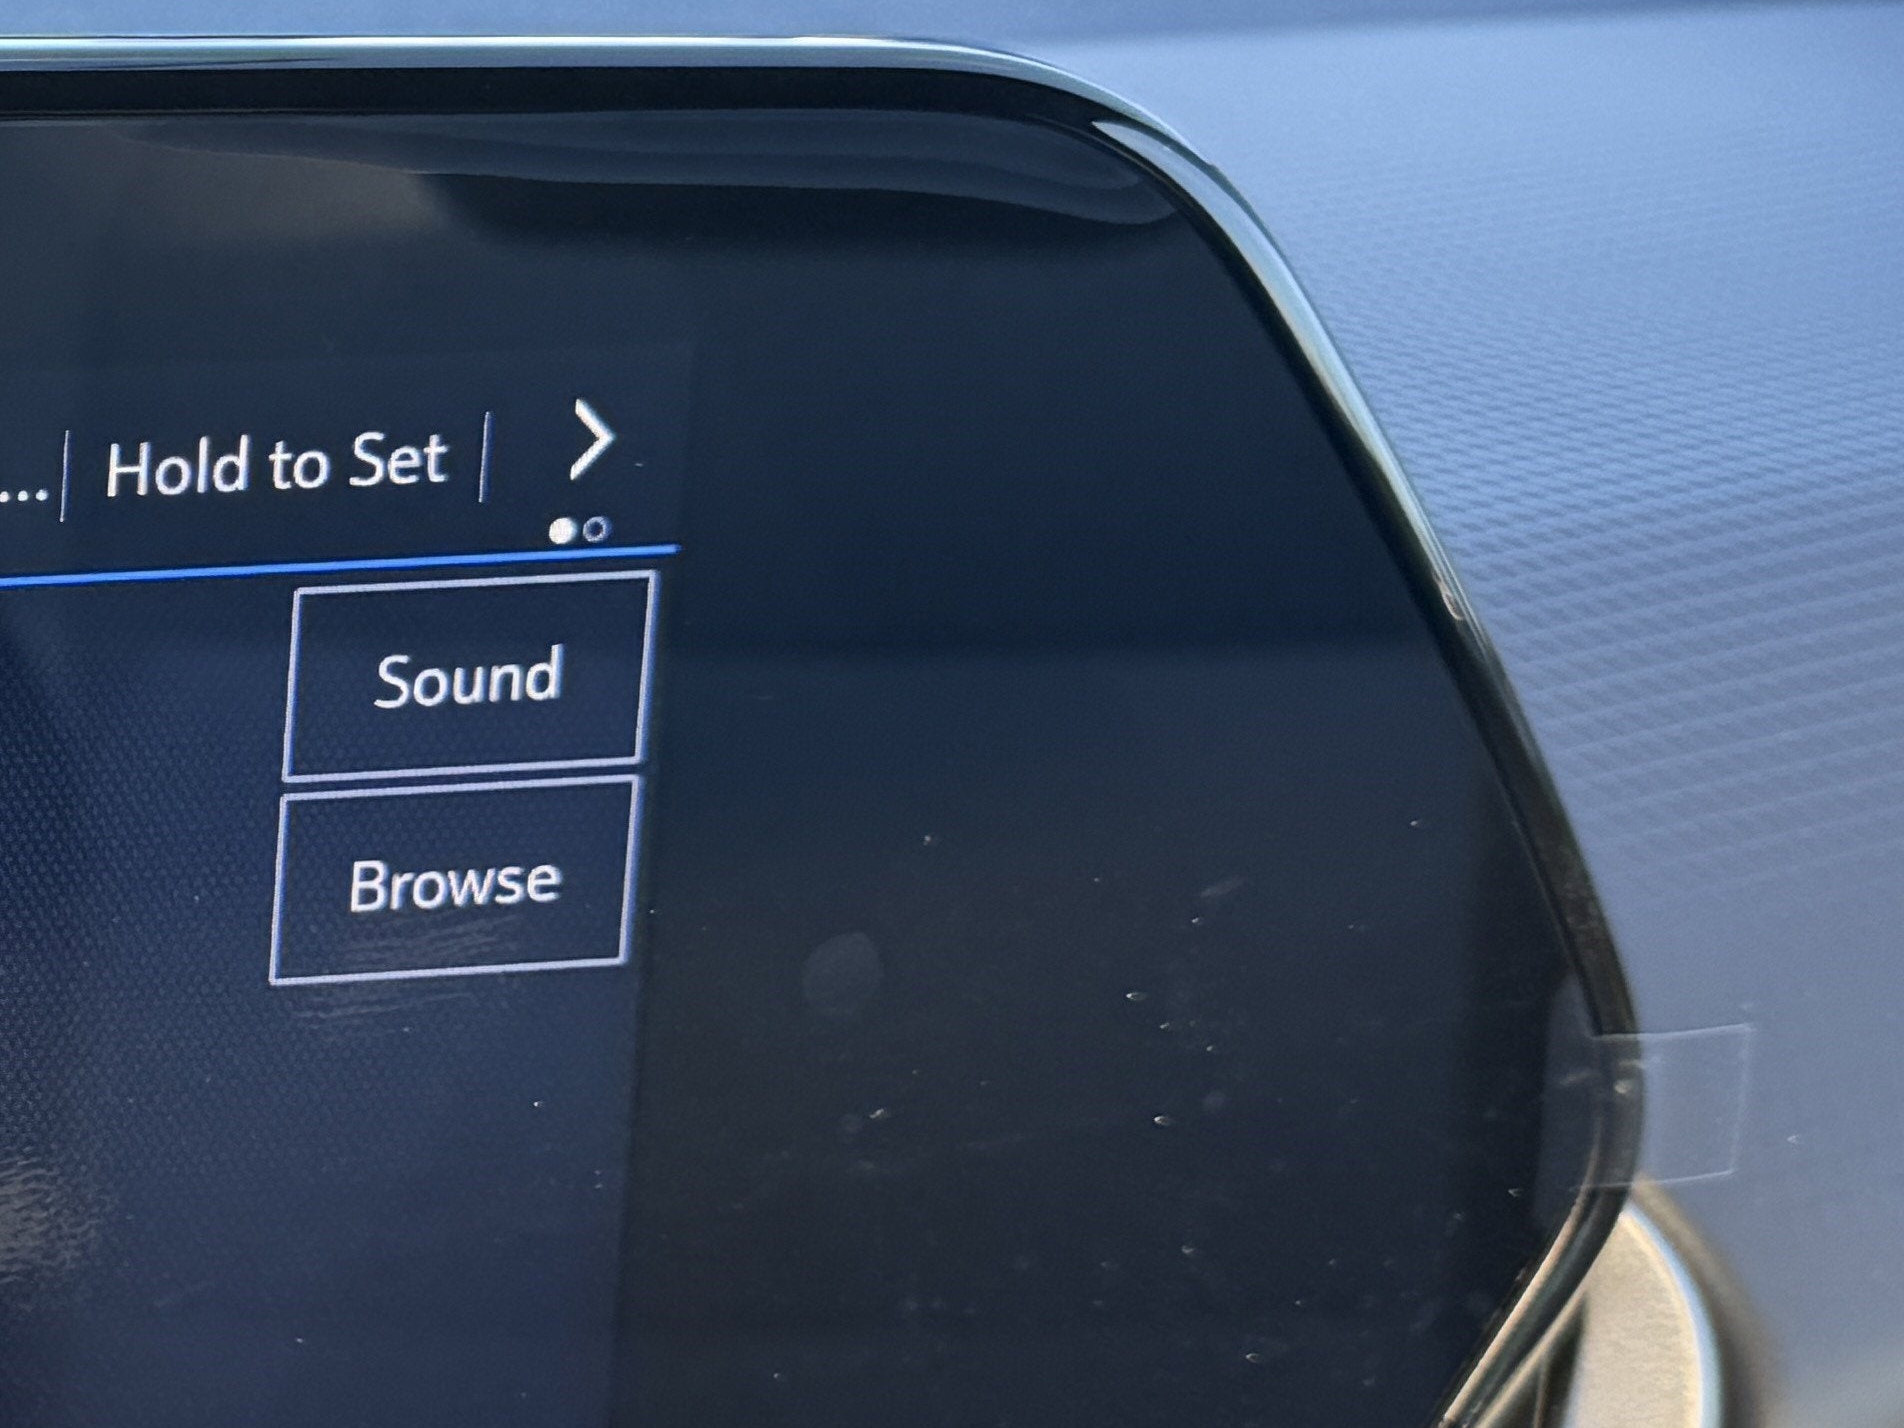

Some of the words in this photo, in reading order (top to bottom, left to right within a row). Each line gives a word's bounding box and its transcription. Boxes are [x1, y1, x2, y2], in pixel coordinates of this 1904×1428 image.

[104, 432, 252, 500] Hold
[267, 438, 332, 492] to
[347, 429, 451, 489] Set
[372, 641, 565, 710] Sound
[348, 856, 564, 915] Browse
